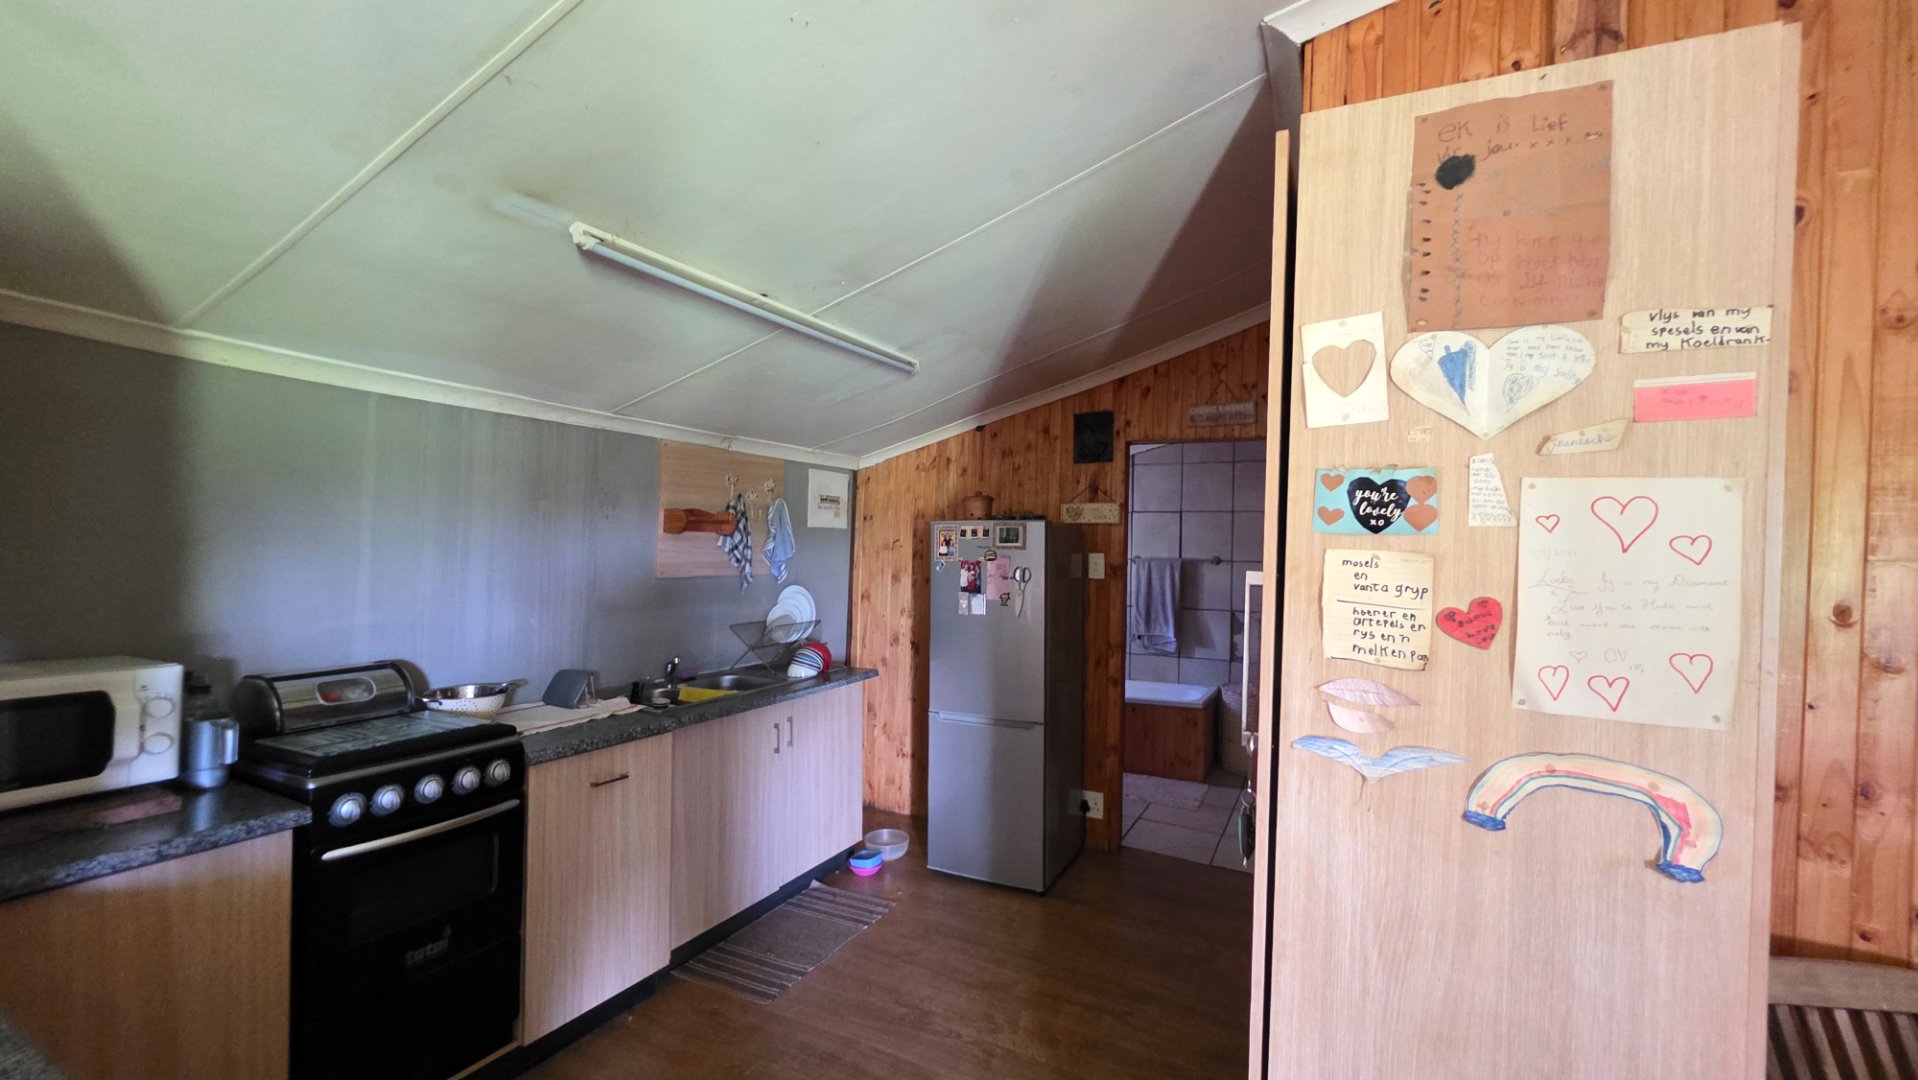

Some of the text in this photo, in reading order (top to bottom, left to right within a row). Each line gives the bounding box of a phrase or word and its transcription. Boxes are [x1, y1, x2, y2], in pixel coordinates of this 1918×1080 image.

[1649, 308, 1680, 323] vlys
[1726, 307, 1751, 319] my
[1651, 320, 1704, 337] spesels
[1646, 341, 1669, 351] my
[1353, 486, 1398, 505] you're
[1359, 501, 1402, 522] lovely
[1353, 572, 1368, 580] en
[1395, 584, 1429, 600] gryp
[1402, 612, 1417, 621] en
[1410, 623, 1426, 631] en
[1353, 628, 1376, 639] rys
[1380, 633, 1395, 643] en
